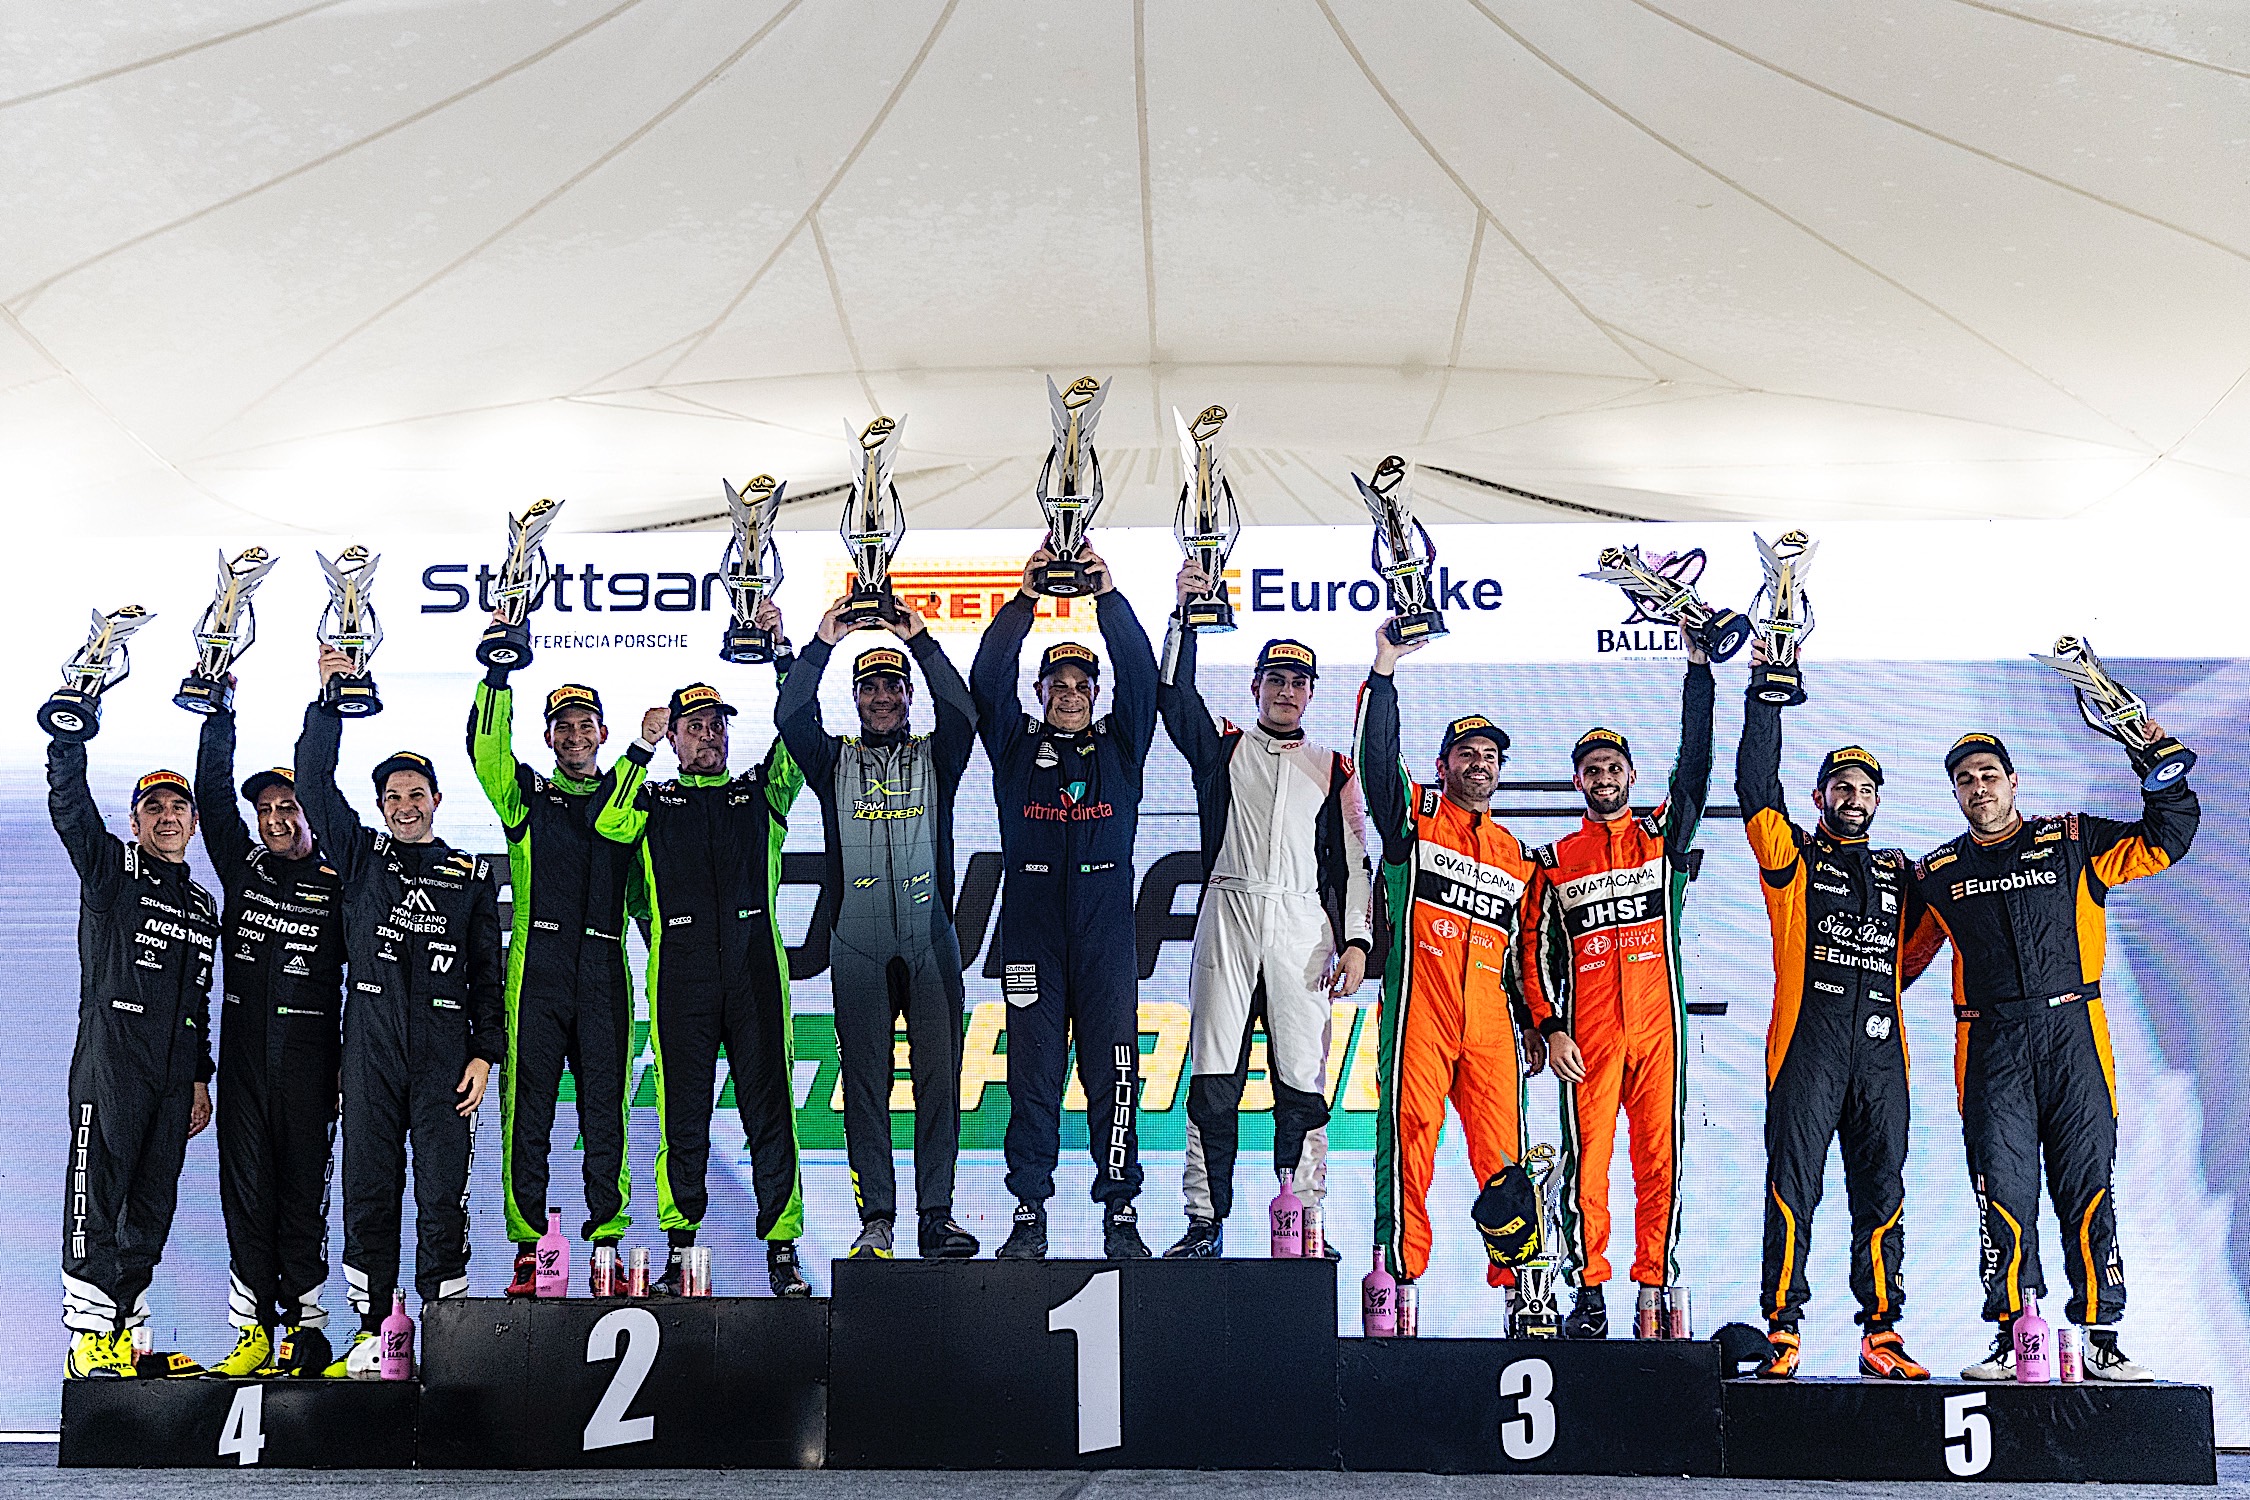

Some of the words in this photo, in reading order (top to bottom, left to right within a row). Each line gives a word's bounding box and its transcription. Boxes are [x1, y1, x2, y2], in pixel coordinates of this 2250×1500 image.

[848, 531, 891, 540] ENDURANCE
[1381, 559, 1424, 574] ENDURANCE
[420, 563, 742, 614] Stttgar
[728, 576, 772, 584] ENDURANCE
[1252, 567, 1503, 611] Euroke
[1758, 618, 1804, 629] ENDURANCE
[614, 634, 688, 648] PORSCHE
[1596, 630, 1684, 653] BALLE
[862, 655, 899, 667] PIRELLI
[1052, 649, 1090, 660] PIRELLI
[1271, 646, 1310, 661] PIRELLI
[853, 800, 886, 811] TEAM
[1023, 801, 1068, 823] vitrine
[1071, 801, 1114, 821] direta
[1025, 864, 1048, 873] sparco
[1433, 853, 1516, 893] GVATACAMA
[1566, 868, 1655, 899] GVATACAMA
[1965, 868, 2057, 896] Eurobike
[1441, 883, 1505, 920] JHSF
[1581, 895, 1648, 928] JHSF
[241, 909, 320, 938] Netshoes
[392, 906, 448, 926] MONEZANO
[533, 920, 559, 931] sparco
[669, 916, 692, 927] sparco
[134, 932, 168, 950] ZIYOU
[144, 918, 213, 949] Netshoes
[237, 926, 266, 942] ZIYOU
[1613, 933, 1657, 951] JUSTIÇA
[1817, 914, 1853, 938] São
[1854, 923, 1897, 949] Bento
[1580, 959, 1606, 973] sparco
[1827, 948, 1893, 976] Eurobike
[1814, 981, 1844, 995] sparco
[112, 1000, 144, 1014] sparco
[1865, 1014, 1892, 1041] 64
[1109, 1044, 1132, 1181] PORSCHE
[72, 1103, 93, 1259] PORSCHE
[1531, 1302, 1541, 1312] 3
[1047, 1269, 1122, 1454] 1
[582, 1307, 660, 1451] 2
[1499, 1358, 1556, 1460] 3
[217, 1383, 266, 1465] 4
[1943, 1391, 1992, 1477] 5
